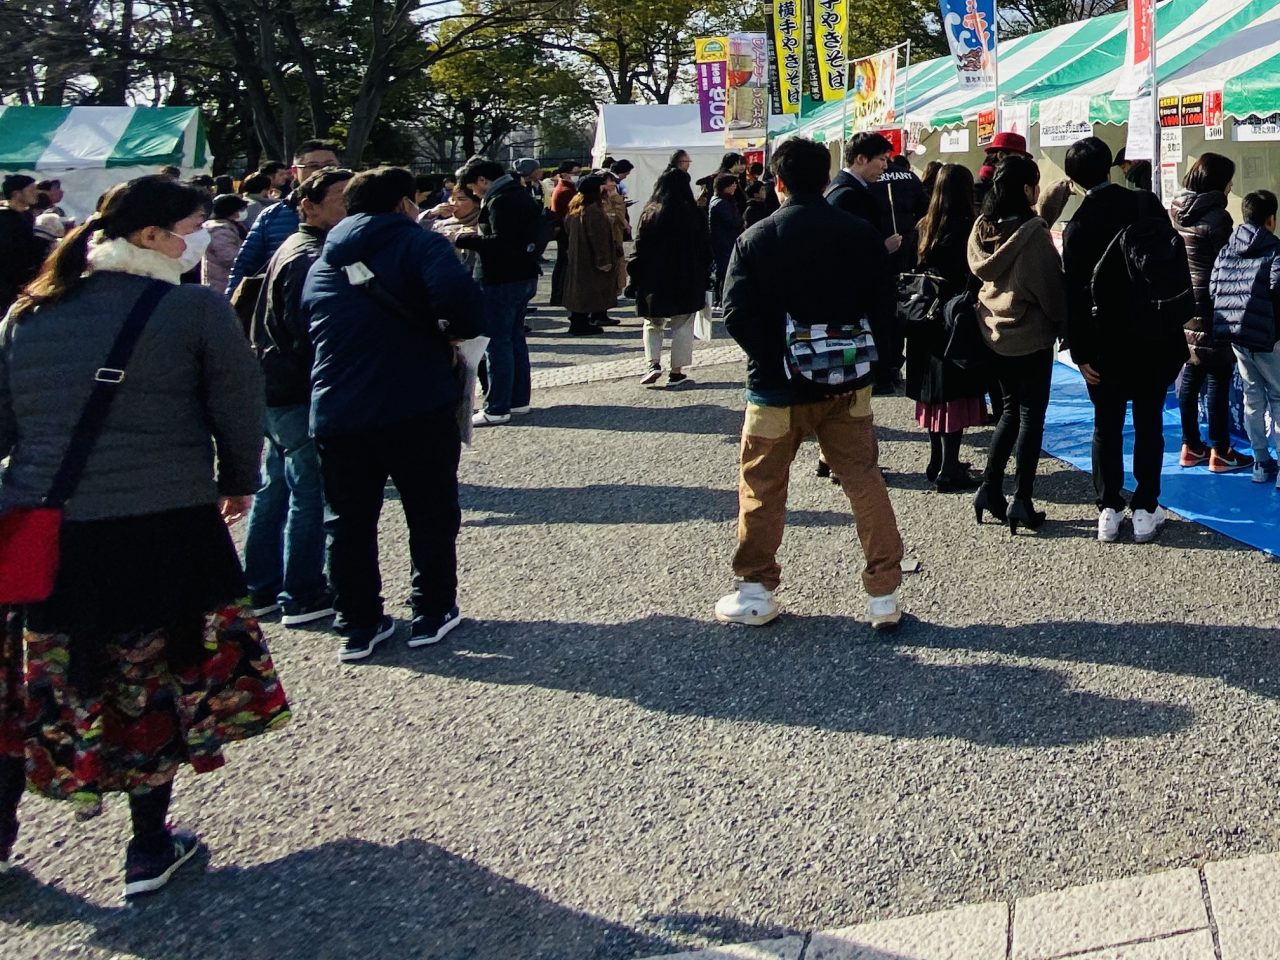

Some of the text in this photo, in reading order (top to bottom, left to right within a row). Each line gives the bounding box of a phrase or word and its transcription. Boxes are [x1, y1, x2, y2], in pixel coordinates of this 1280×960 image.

[778, 0, 800, 105] 横手やきそば
